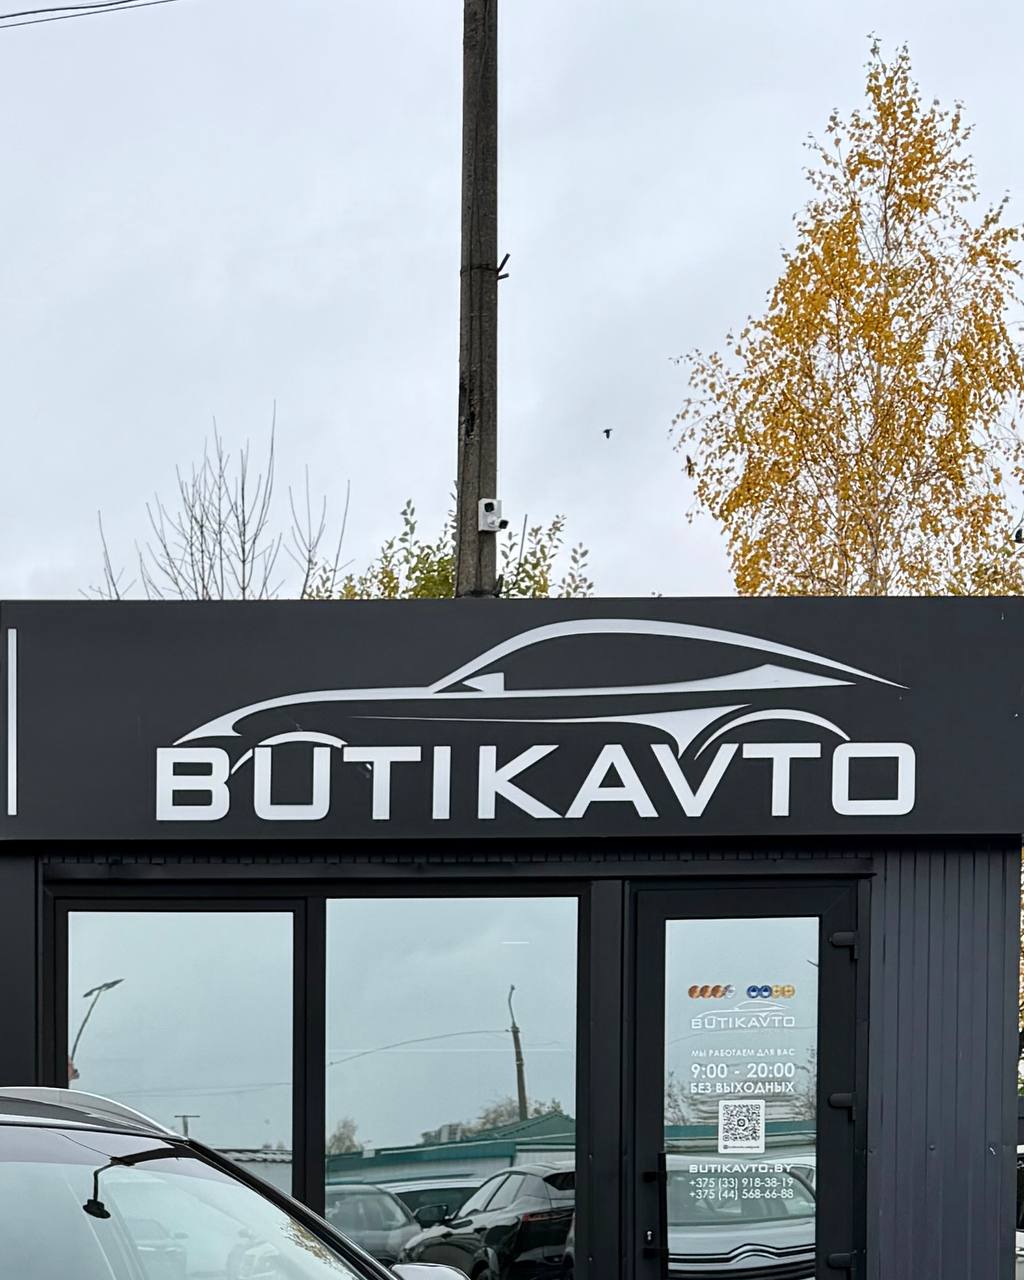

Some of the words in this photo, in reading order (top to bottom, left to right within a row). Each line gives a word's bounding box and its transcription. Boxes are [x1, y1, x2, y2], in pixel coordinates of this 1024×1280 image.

[155, 741, 916, 822] BUTIKAVTO
[691, 1017, 795, 1028] BUTIKAVTO
[777, 1048, 795, 1056] ВАС
[691, 1064, 727, 1078] 9:00
[747, 1063, 795, 1078] 20:00
[690, 1083, 711, 1093] БЕЗ
[716, 1082, 794, 1093] ВЫХОДНЫХ
[689, 1164, 792, 1173] BUTIKAVTO.BY
[690, 1178, 715, 1188] +375
[718, 1177, 738, 1189] (33)
[742, 1178, 793, 1188] 918-38-19
[690, 1190, 715, 1199] +375
[718, 1189, 738, 1200] (44)
[742, 1189, 793, 1199] 568-66-88
